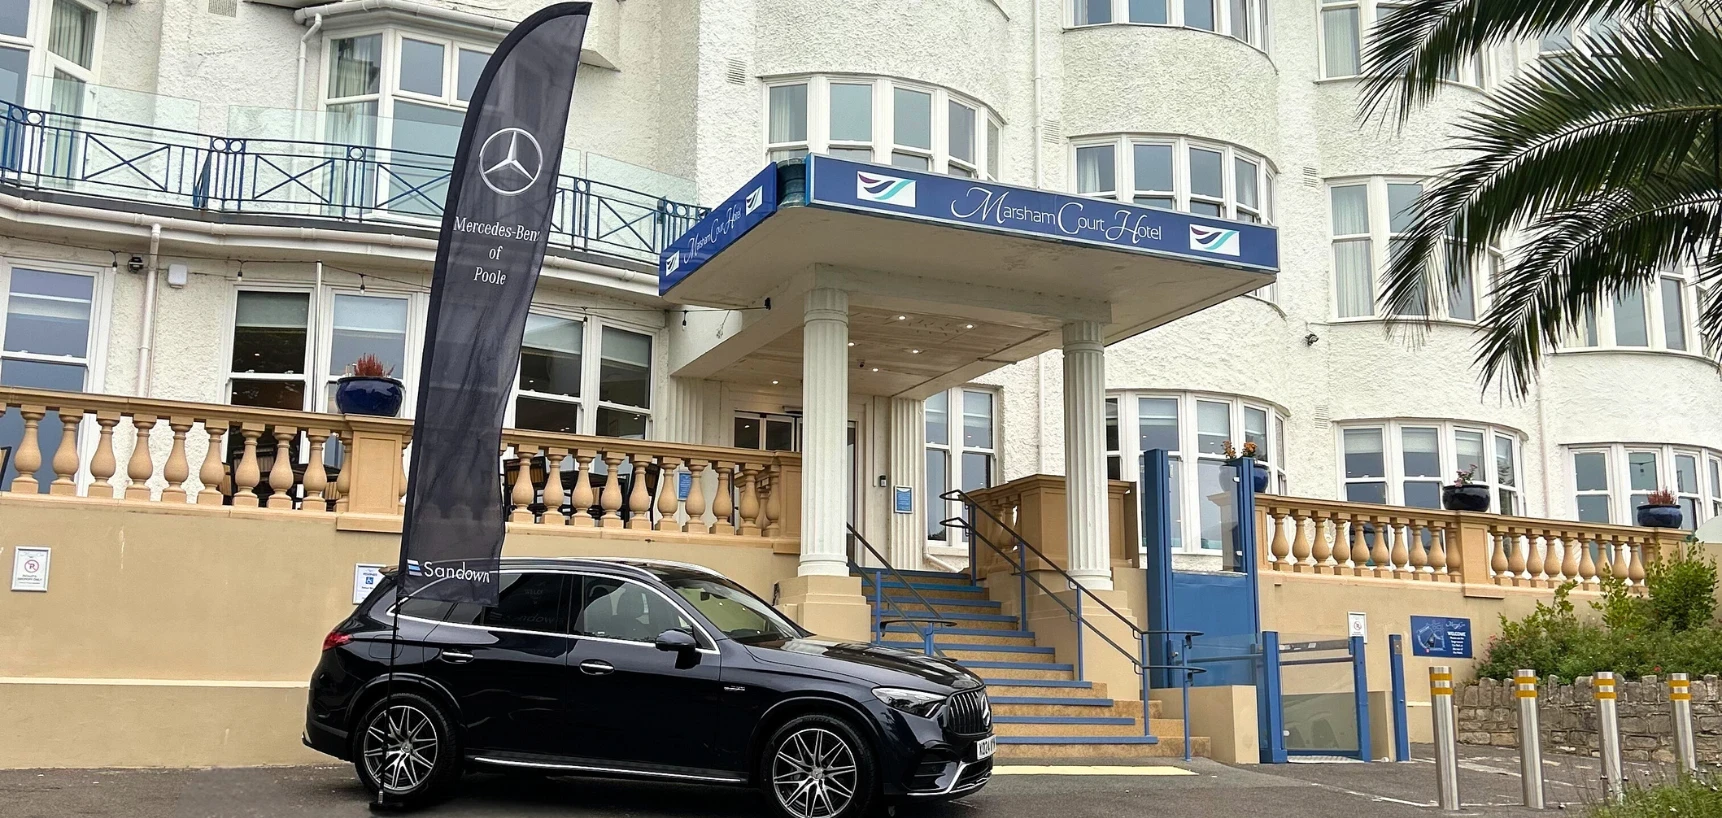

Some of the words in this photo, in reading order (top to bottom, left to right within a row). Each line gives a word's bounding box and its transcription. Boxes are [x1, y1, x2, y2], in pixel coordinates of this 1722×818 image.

[951, 187, 1055, 224] Marsham
[1058, 202, 1104, 235] Court
[1105, 210, 1162, 244] Hotel
[489, 246, 503, 260] of
[684, 233, 711, 264] Marsham
[473, 266, 507, 285] Poole
[424, 561, 490, 584] Sandown
